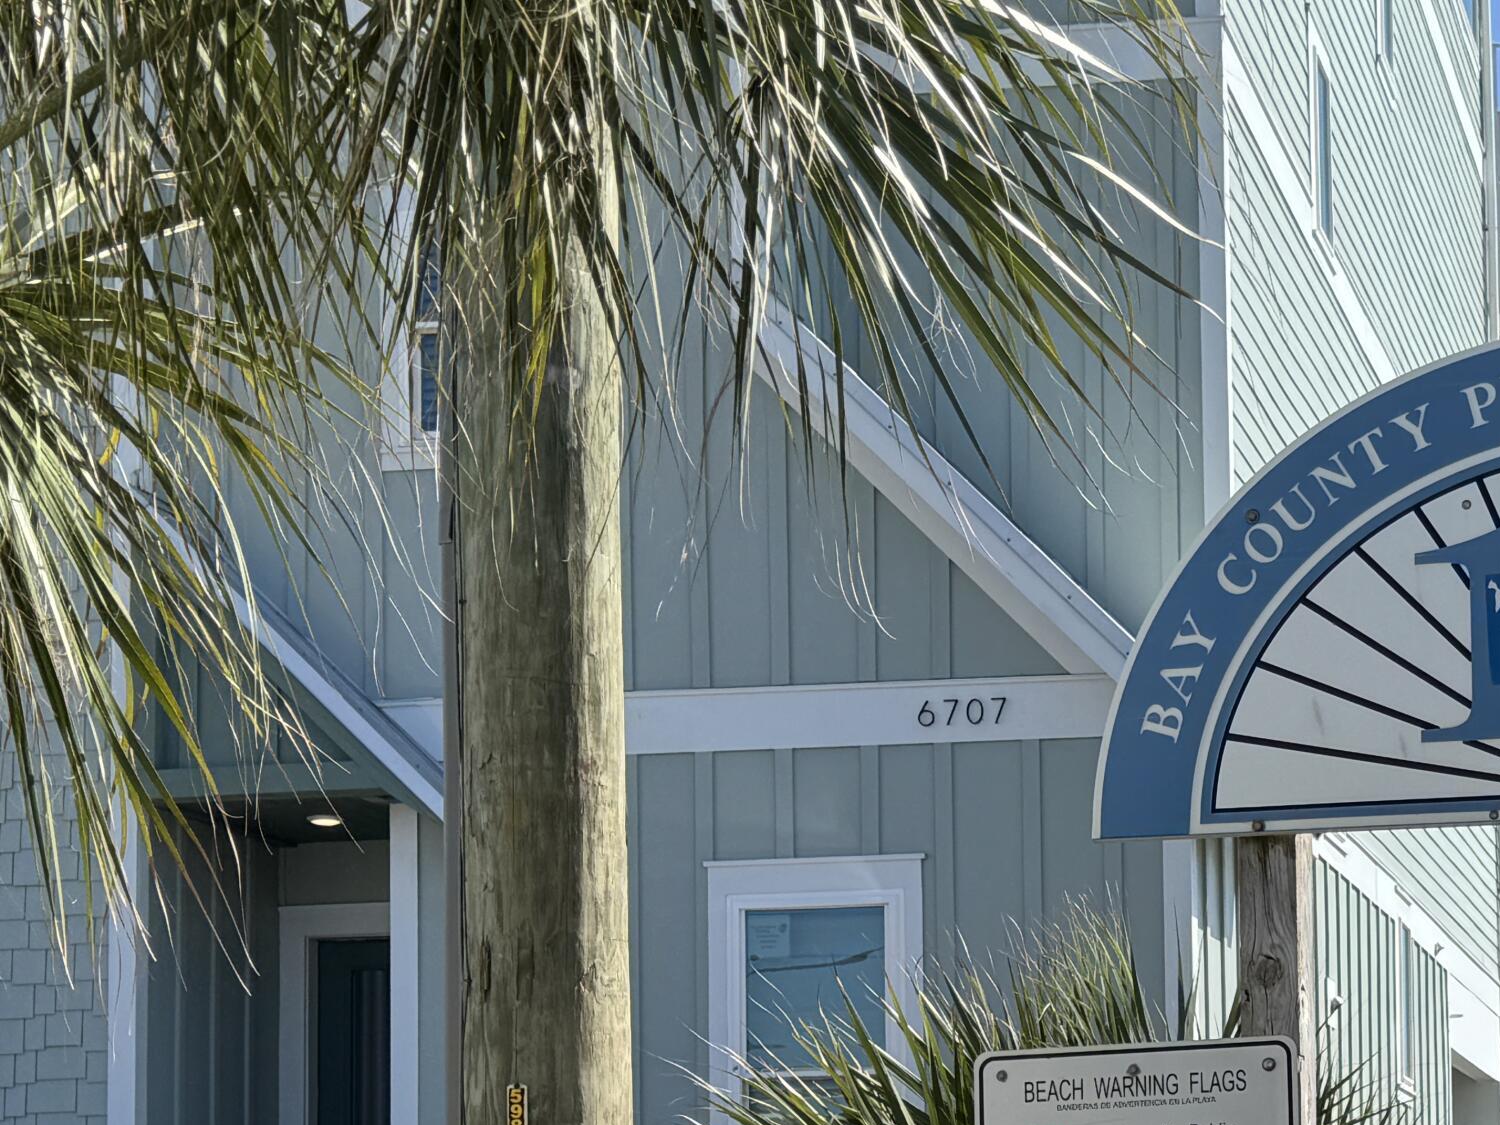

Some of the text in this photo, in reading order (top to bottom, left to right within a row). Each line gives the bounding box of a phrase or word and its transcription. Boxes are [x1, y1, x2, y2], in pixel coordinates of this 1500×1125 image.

[1140, 610, 1217, 743] BAY
[1216, 403, 1432, 596] COUNTY
[917, 696, 1007, 727] 6707
[1024, 1069, 1247, 1103] BEACH WARNING FLAGS
